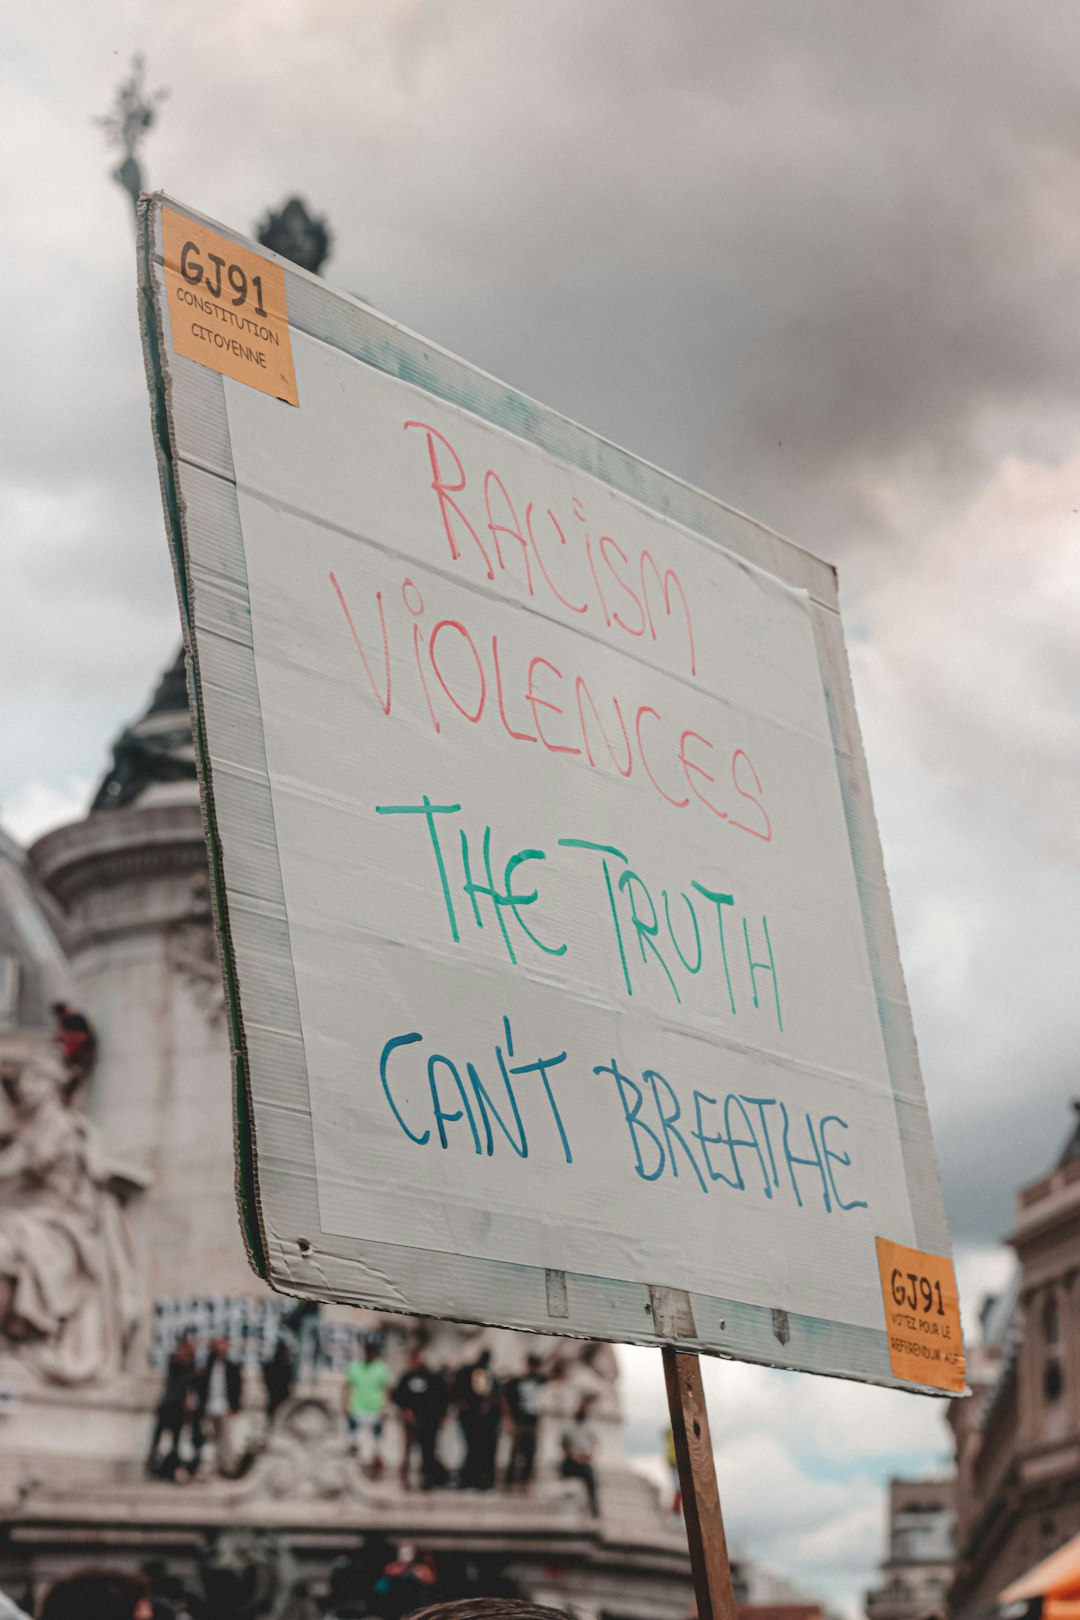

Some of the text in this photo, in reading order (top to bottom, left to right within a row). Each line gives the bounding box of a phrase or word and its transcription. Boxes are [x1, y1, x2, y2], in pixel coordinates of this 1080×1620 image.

[180, 241, 268, 318] GJ91
[176, 287, 280, 347] CONSTITUTION
[191, 322, 267, 369] CITOYENNE
[375, 795, 784, 1033] THE TRUTH
[379, 1014, 869, 1214] CAN'T BREATHE
[890, 1267, 946, 1317] GJ91
[890, 1312, 952, 1340] VOTEZ POUR LE
